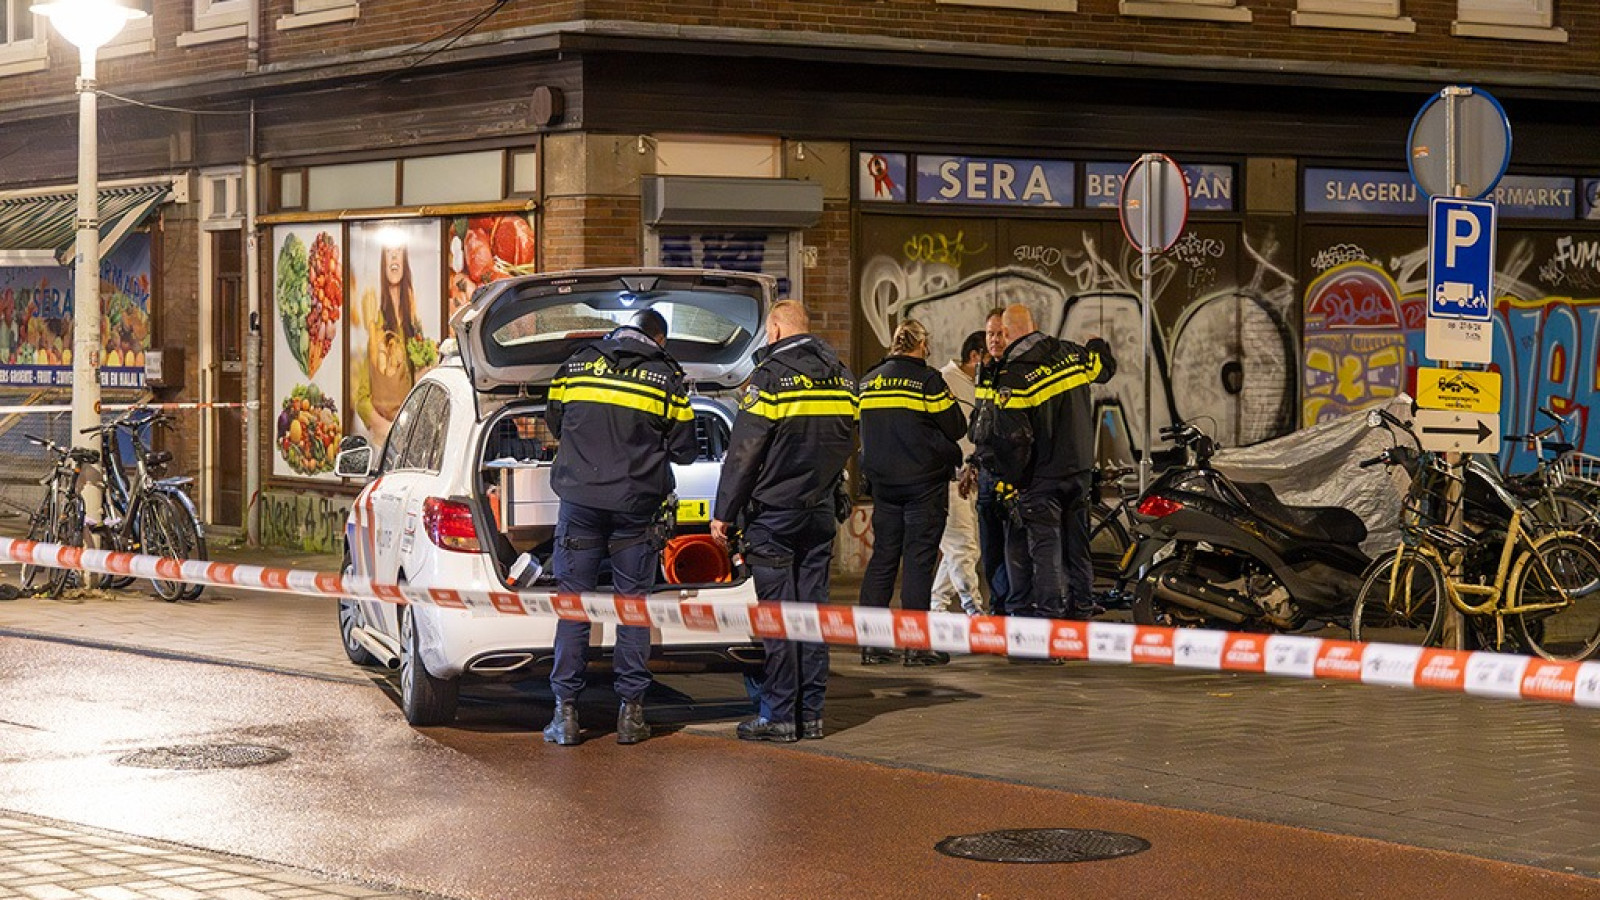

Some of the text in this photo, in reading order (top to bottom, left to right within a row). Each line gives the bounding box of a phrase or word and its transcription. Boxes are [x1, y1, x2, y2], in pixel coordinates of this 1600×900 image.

[940, 161, 1053, 201] SERA
[1325, 181, 1416, 203] SLAGERIJ
[1446, 209, 1481, 268] P
[33, 287, 75, 318] SERA
